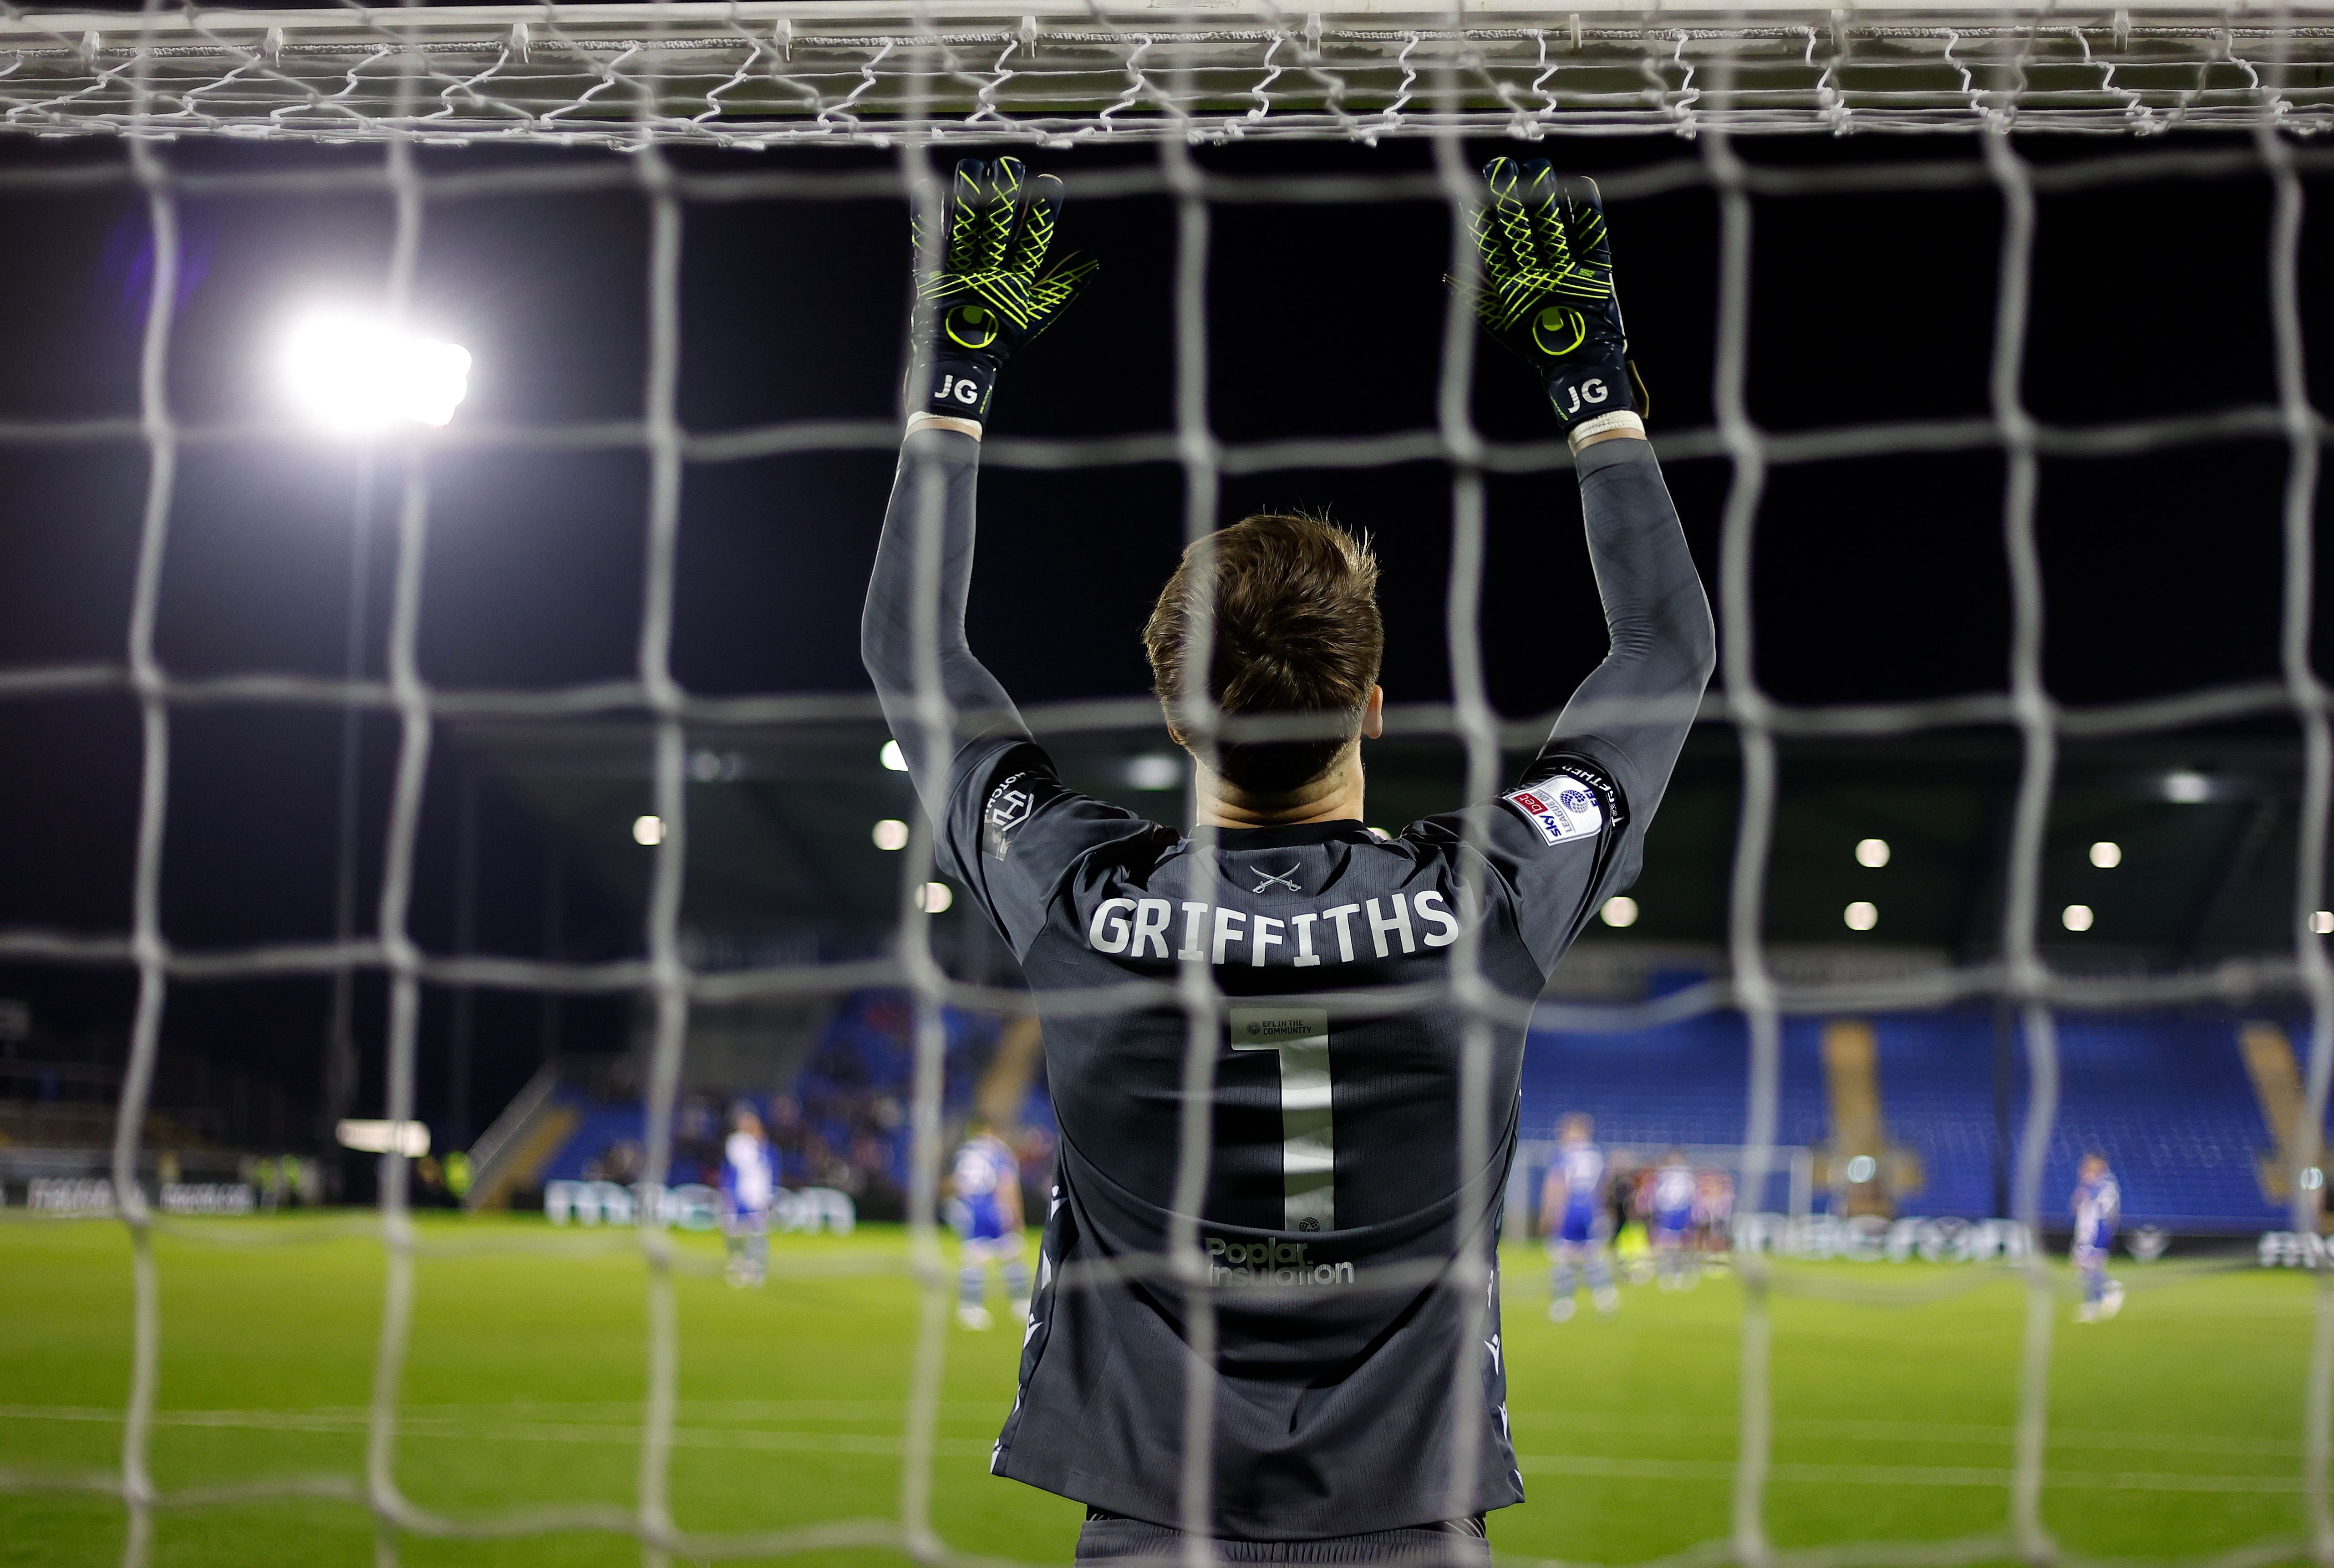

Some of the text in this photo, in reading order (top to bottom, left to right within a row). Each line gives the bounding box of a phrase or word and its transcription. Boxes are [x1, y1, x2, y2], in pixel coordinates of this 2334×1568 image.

[934, 374, 978, 404] JG
[1567, 378, 1608, 413] JG
[1519, 794, 1561, 837] sky bet
[1531, 789, 1572, 833] LEAGUE ONE
[1089, 890, 1459, 967] GRIFFITHS
[1263, 1026, 1312, 1034] COMMUNITY
[1230, 1008, 1334, 1231] 1
[1205, 1237, 1308, 1269] Poplar
[1208, 1259, 1355, 1287] Insulation
